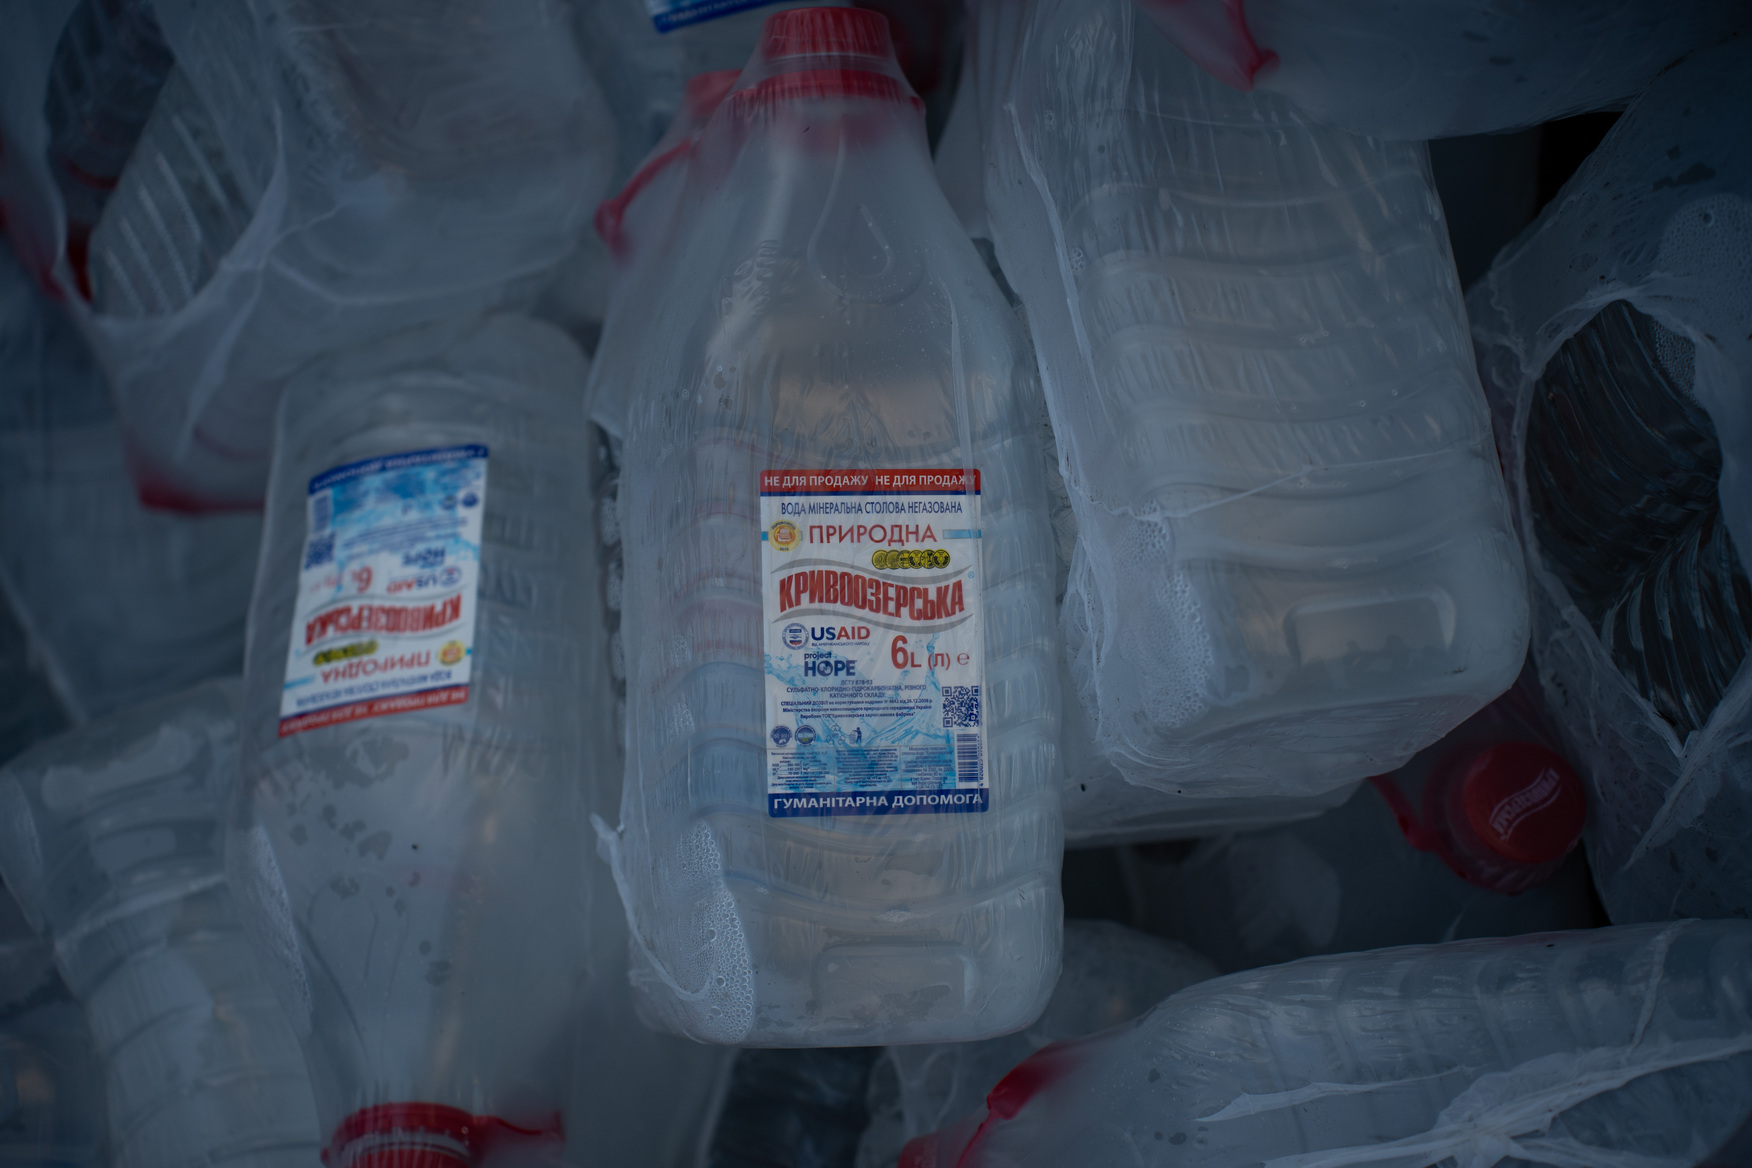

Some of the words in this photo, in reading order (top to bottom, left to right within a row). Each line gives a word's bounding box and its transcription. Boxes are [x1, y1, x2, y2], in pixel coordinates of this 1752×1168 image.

[764, 475, 780, 487] НЕ
[782, 475, 807, 488] ДЛЯ
[808, 474, 868, 488] ПРОДАЖУ
[875, 475, 891, 487] НЕ
[892, 475, 917, 488] ДЛЯ
[781, 502, 807, 515] ВОДА
[808, 501, 863, 514] МІНЕРАЛЬНА
[864, 501, 906, 514] СТОЛОВА
[907, 501, 962, 513] НЕГАЗОВАНА
[809, 524, 938, 546] ПРИРОДНА
[779, 570, 965, 621] КРИВООЗЕРСЬКА
[305, 593, 462, 646] КРИВООЗЕРСЬКА
[811, 626, 870, 641] USAID
[804, 651, 832, 660] project
[320, 649, 431, 684] ПРИРОДНА
[804, 660, 856, 677] HOPE
[773, 796, 889, 809] ГУМАНІТАРНА
[891, 794, 983, 808] ДОПОМОГА
